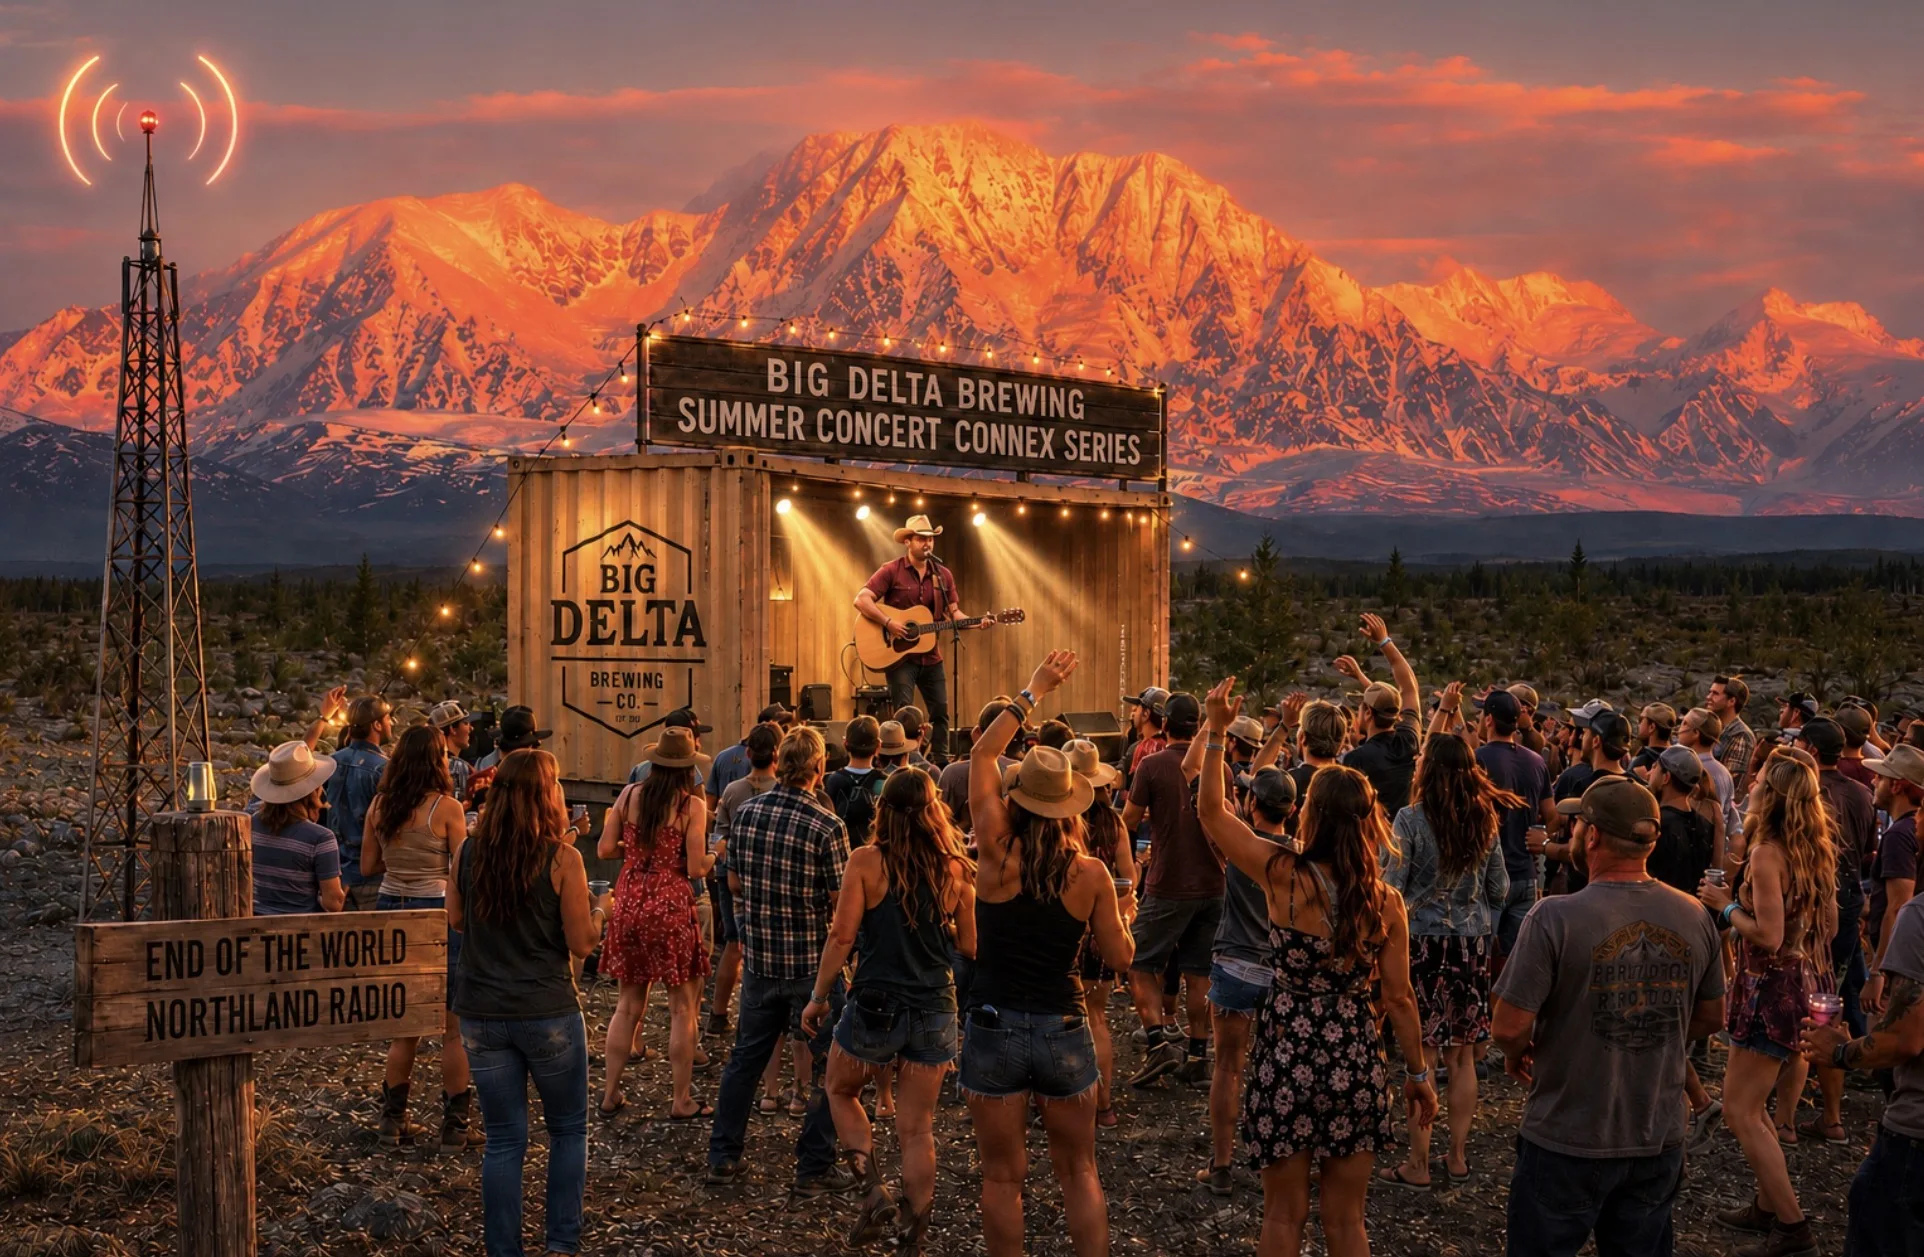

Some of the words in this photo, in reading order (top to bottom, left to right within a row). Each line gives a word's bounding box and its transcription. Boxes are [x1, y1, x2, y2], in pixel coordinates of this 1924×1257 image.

[766, 357, 829, 397] BIG
[848, 366, 944, 408] DELTA
[958, 377, 1085, 420] BREWING
[677, 396, 805, 441] SUMMER
[817, 408, 942, 451] CONCERT
[954, 420, 1056, 459] CONNEX
[1064, 429, 1141, 465] SERIES
[600, 563, 656, 594] BIG
[550, 599, 707, 647] DELTA
[590, 671, 664, 689] BREWING
[146, 939, 204, 982] END
[215, 936, 250, 976] OF
[260, 933, 310, 973] THE
[320, 928, 406, 969] WORLD
[144, 989, 319, 1042] NORTHLAND
[330, 982, 406, 1025] RADIO
